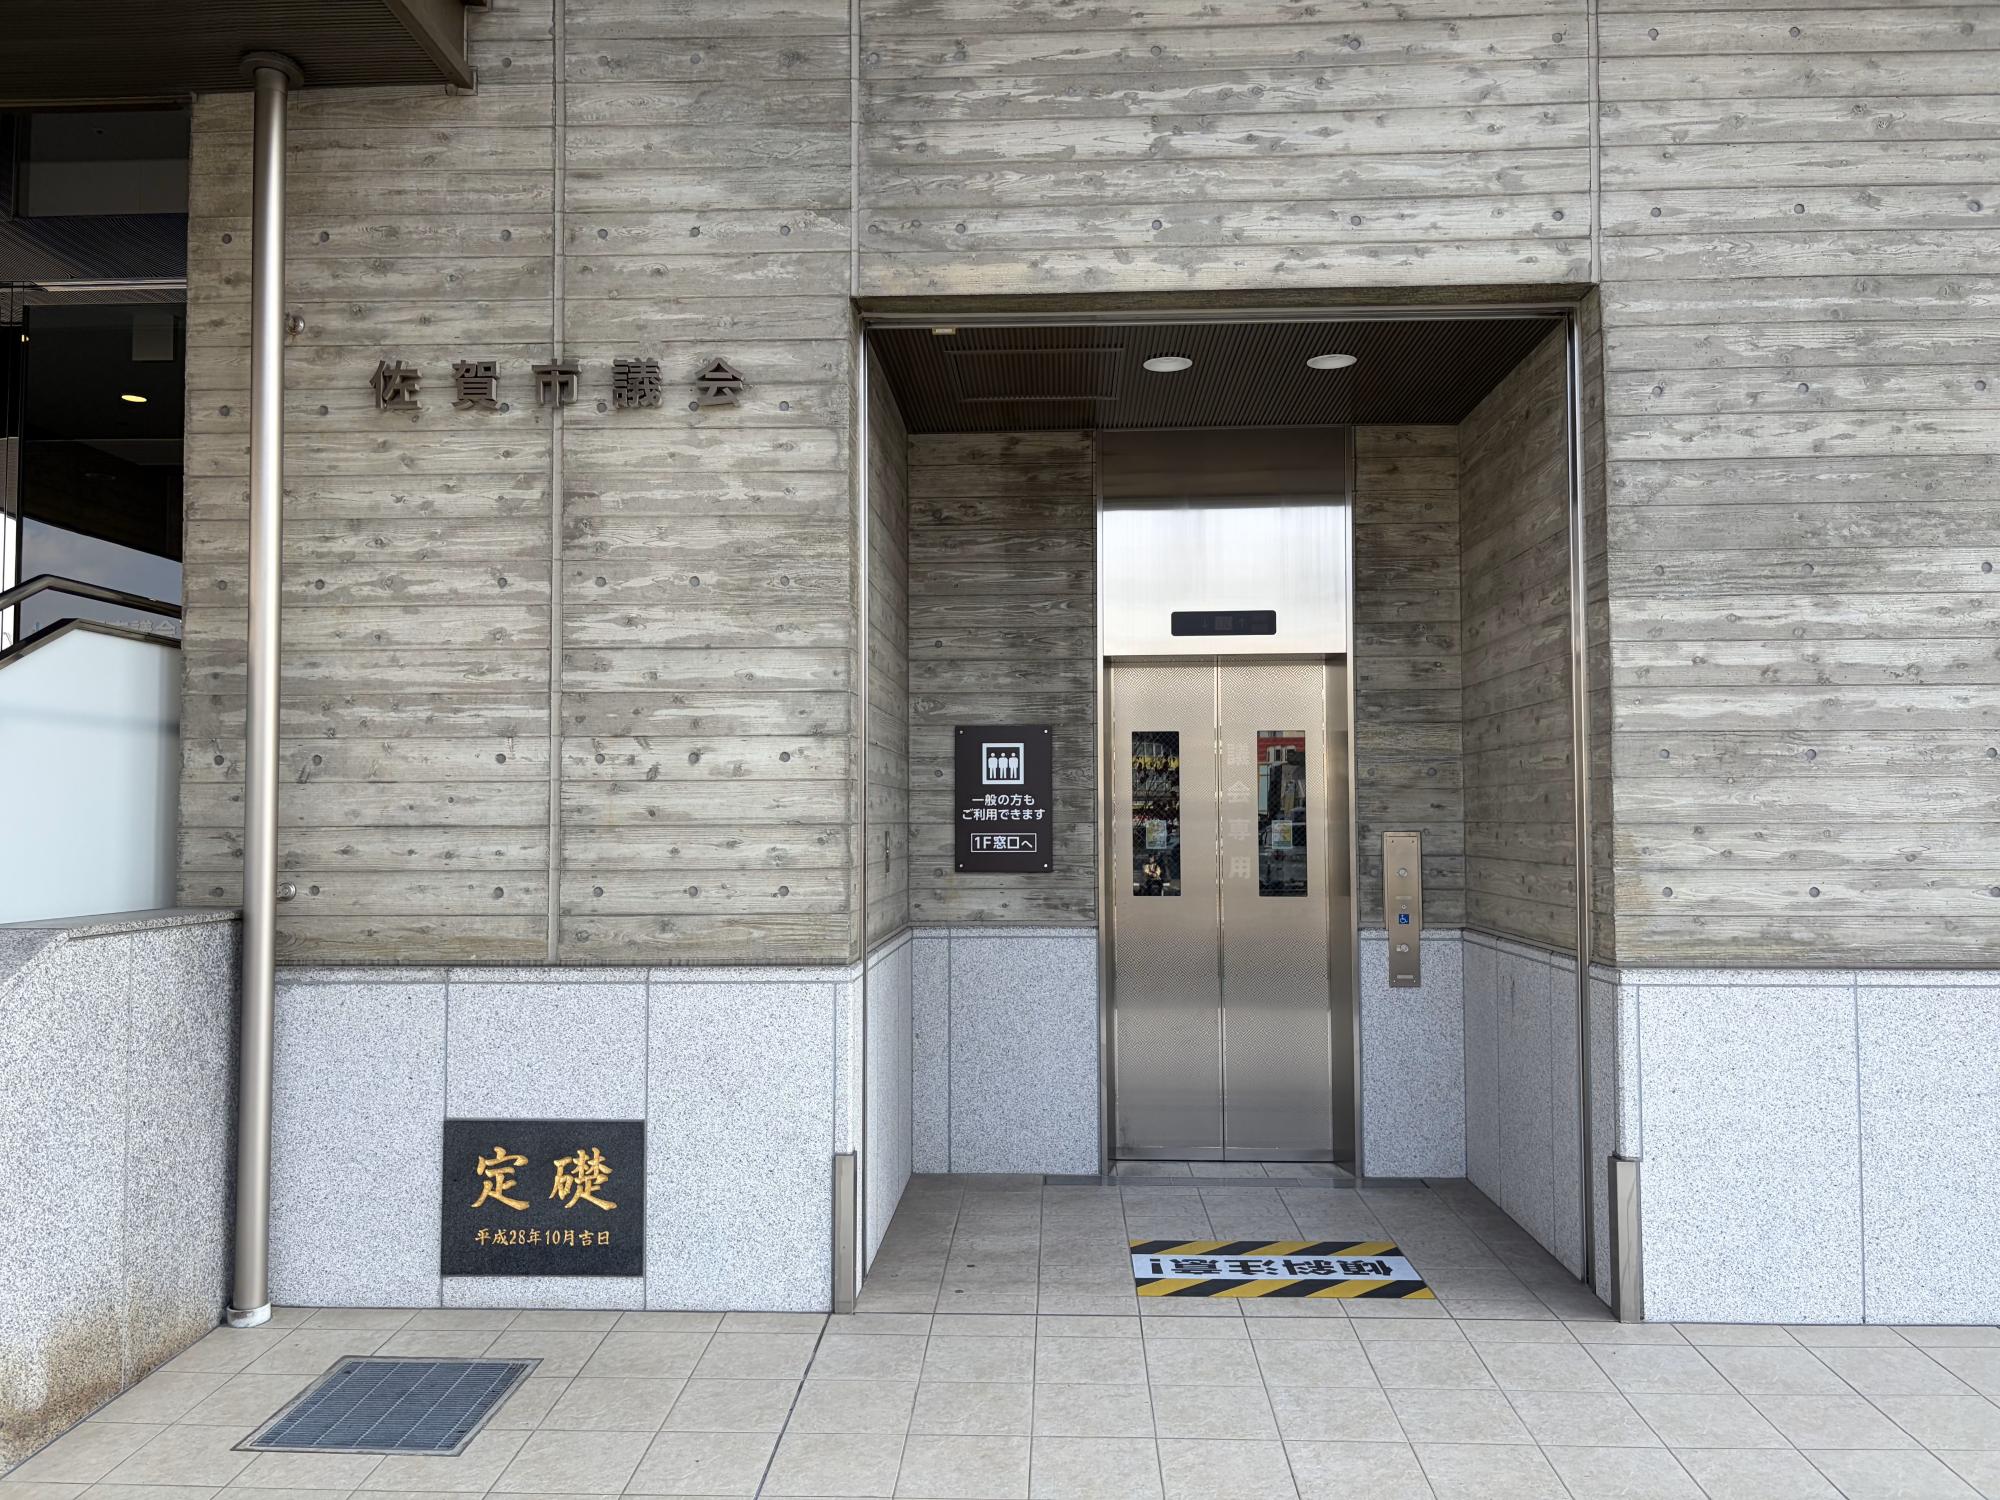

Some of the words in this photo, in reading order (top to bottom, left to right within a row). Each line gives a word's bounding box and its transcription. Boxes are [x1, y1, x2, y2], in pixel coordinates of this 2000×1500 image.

[369, 357, 745, 411] 佐賀市議会
[971, 793, 1035, 807] 一般の方も
[962, 807, 1046, 821] ご利用できます
[974, 835, 1033, 850] 1F窓口へ
[471, 1145, 618, 1211] 定礎
[474, 1227, 610, 1247] 平成28年10月吉日
